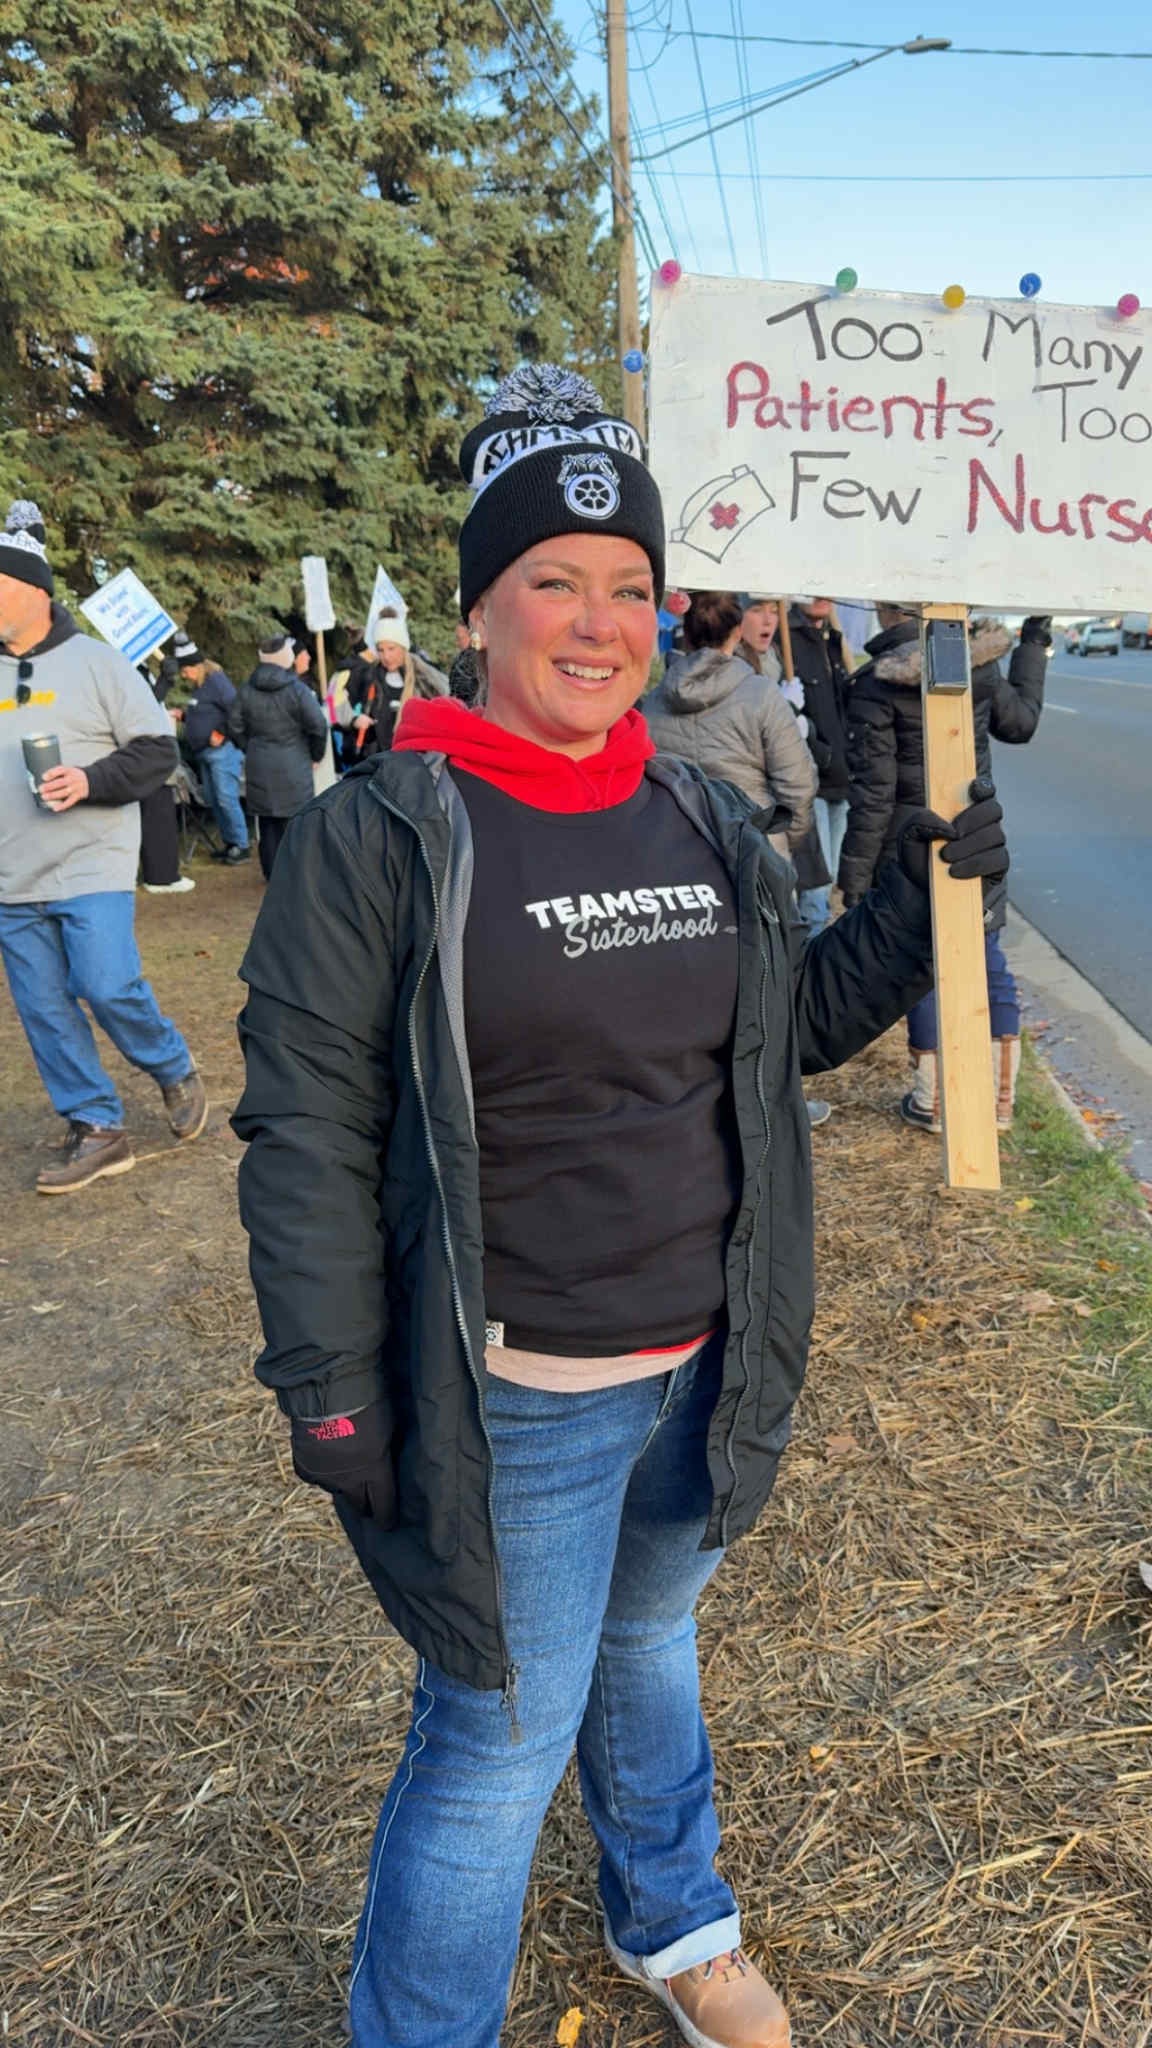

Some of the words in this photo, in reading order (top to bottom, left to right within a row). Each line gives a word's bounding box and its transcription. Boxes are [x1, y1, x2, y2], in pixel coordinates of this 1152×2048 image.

[766, 294, 923, 362] Too
[982, 309, 1143, 390] Many
[726, 361, 1002, 447] Patients,
[1032, 379, 1152, 443] Too
[790, 451, 921, 525] Few
[525, 884, 723, 929] TEAMSTER
[563, 905, 718, 959] Sisterhood
